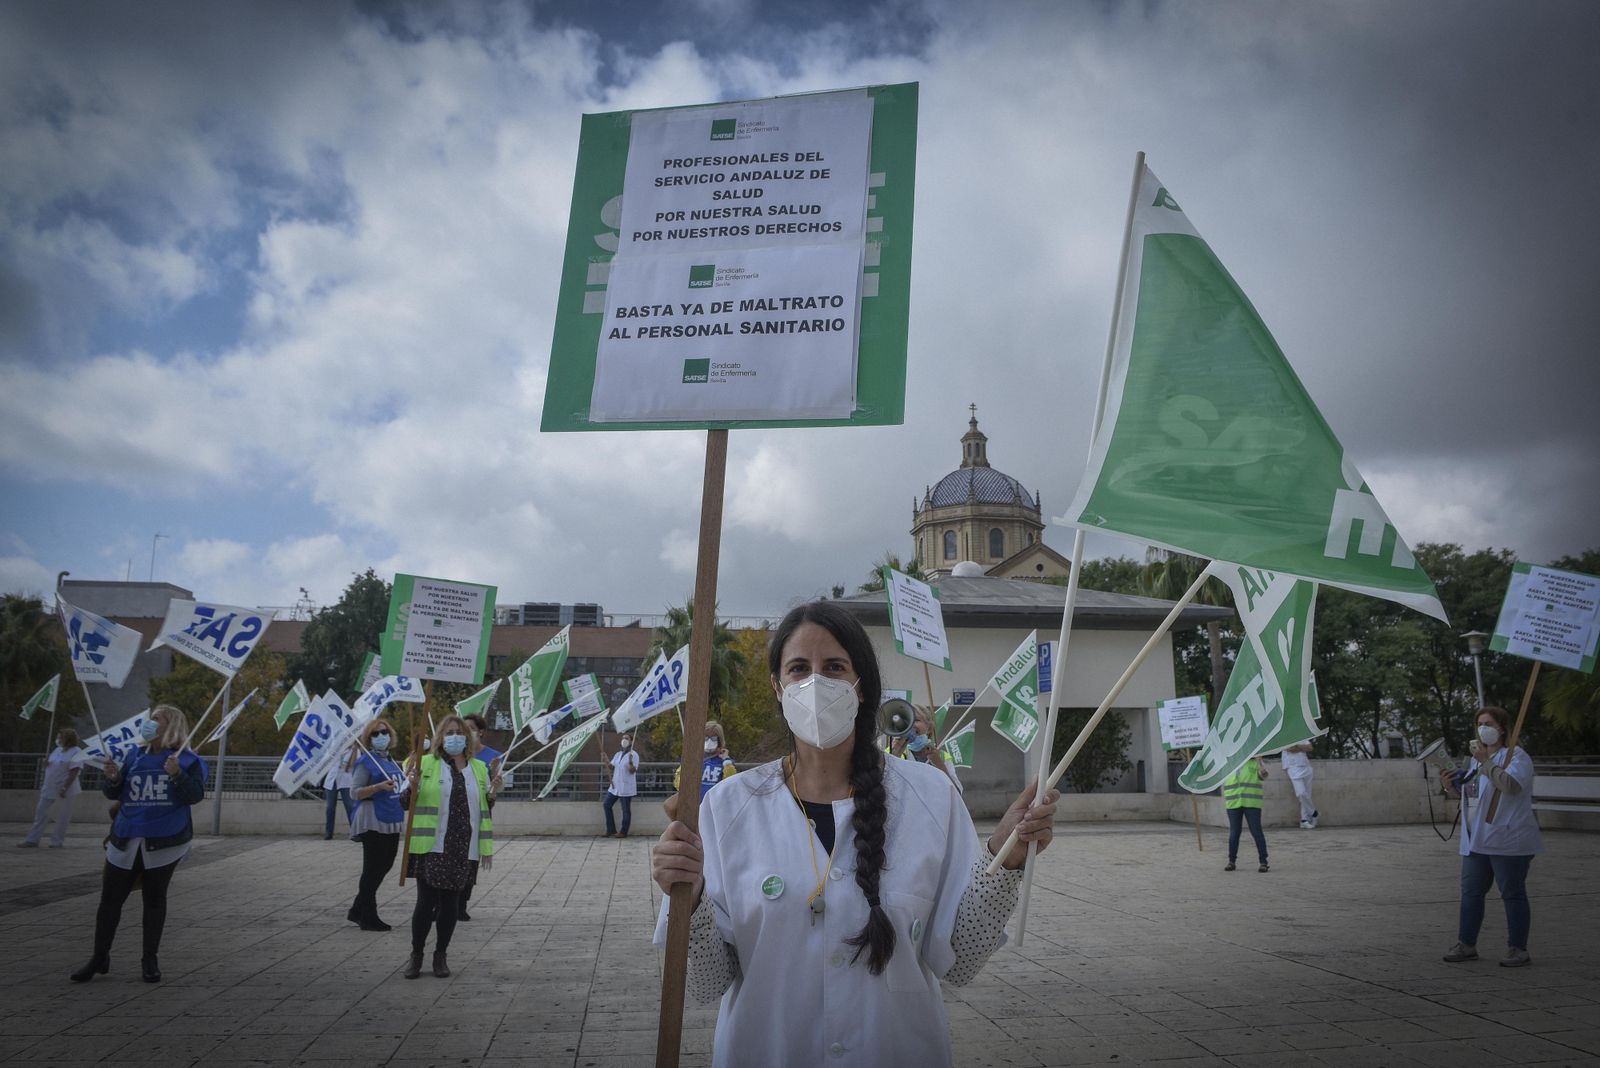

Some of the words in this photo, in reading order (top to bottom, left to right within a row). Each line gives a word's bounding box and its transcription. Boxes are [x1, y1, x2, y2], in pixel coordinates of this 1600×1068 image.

[663, 152, 789, 169] PROFESIONALES
[794, 151, 825, 163] DEL
[654, 172, 725, 188] SERVICIO
[730, 169, 805, 183] ANDALUZ
[810, 168, 831, 180] DE
[712, 188, 764, 200] SALUD
[655, 211, 685, 223] POR
[690, 206, 763, 221] NUESTRA
[768, 204, 822, 216] SALUD
[632, 230, 663, 242] POR
[667, 225, 750, 240] NUESTROS
[755, 221, 842, 235] DERECHOS
[716, 267, 745, 275] Sindicato
[725, 273, 759, 281] Enfermería
[615, 304, 674, 318] BASTA
[679, 303, 704, 316] YA
[710, 301, 733, 314] DE
[739, 295, 844, 312] MALTRATO
[609, 327, 631, 339] AL
[637, 323, 733, 339] PERSONAL
[739, 318, 845, 335] SANITARIO
[720, 369, 757, 377] Enfermería
[1550, 574, 1576, 583] NUESTRA
[1548, 586, 1577, 596] DERECHOS
[1555, 581, 1585, 591] NUESTROS
[440, 594, 470, 602] NUESTROS
[1533, 595, 1561, 605] PERSONAL
[1563, 601, 1593, 611] SANITARIO
[1564, 594, 1594, 606] MALTRATO
[433, 600, 462, 608] DERECHOS
[420, 611, 449, 619] PERSONAL
[450, 614, 479, 622] SANITARIO
[450, 608, 479, 616] MALTRATO
[1537, 617, 1562, 626] NUESTRA
[1563, 622, 1582, 630] SALUD
[1534, 628, 1564, 638] DERECHOS
[1542, 624, 1572, 634] NUESTROS
[426, 634, 452, 642] NUESTRA
[433, 641, 462, 649] NUESTROS
[1520, 637, 1548, 647] PERSONAL
[1550, 644, 1580, 655] SANITARIO
[1550, 638, 1581, 649] MALTRATO
[426, 647, 455, 655] DERECHOS
[413, 658, 441, 666] PERSONAL
[442, 661, 472, 669] SANITARIO
[443, 655, 472, 663] MALTRATO
